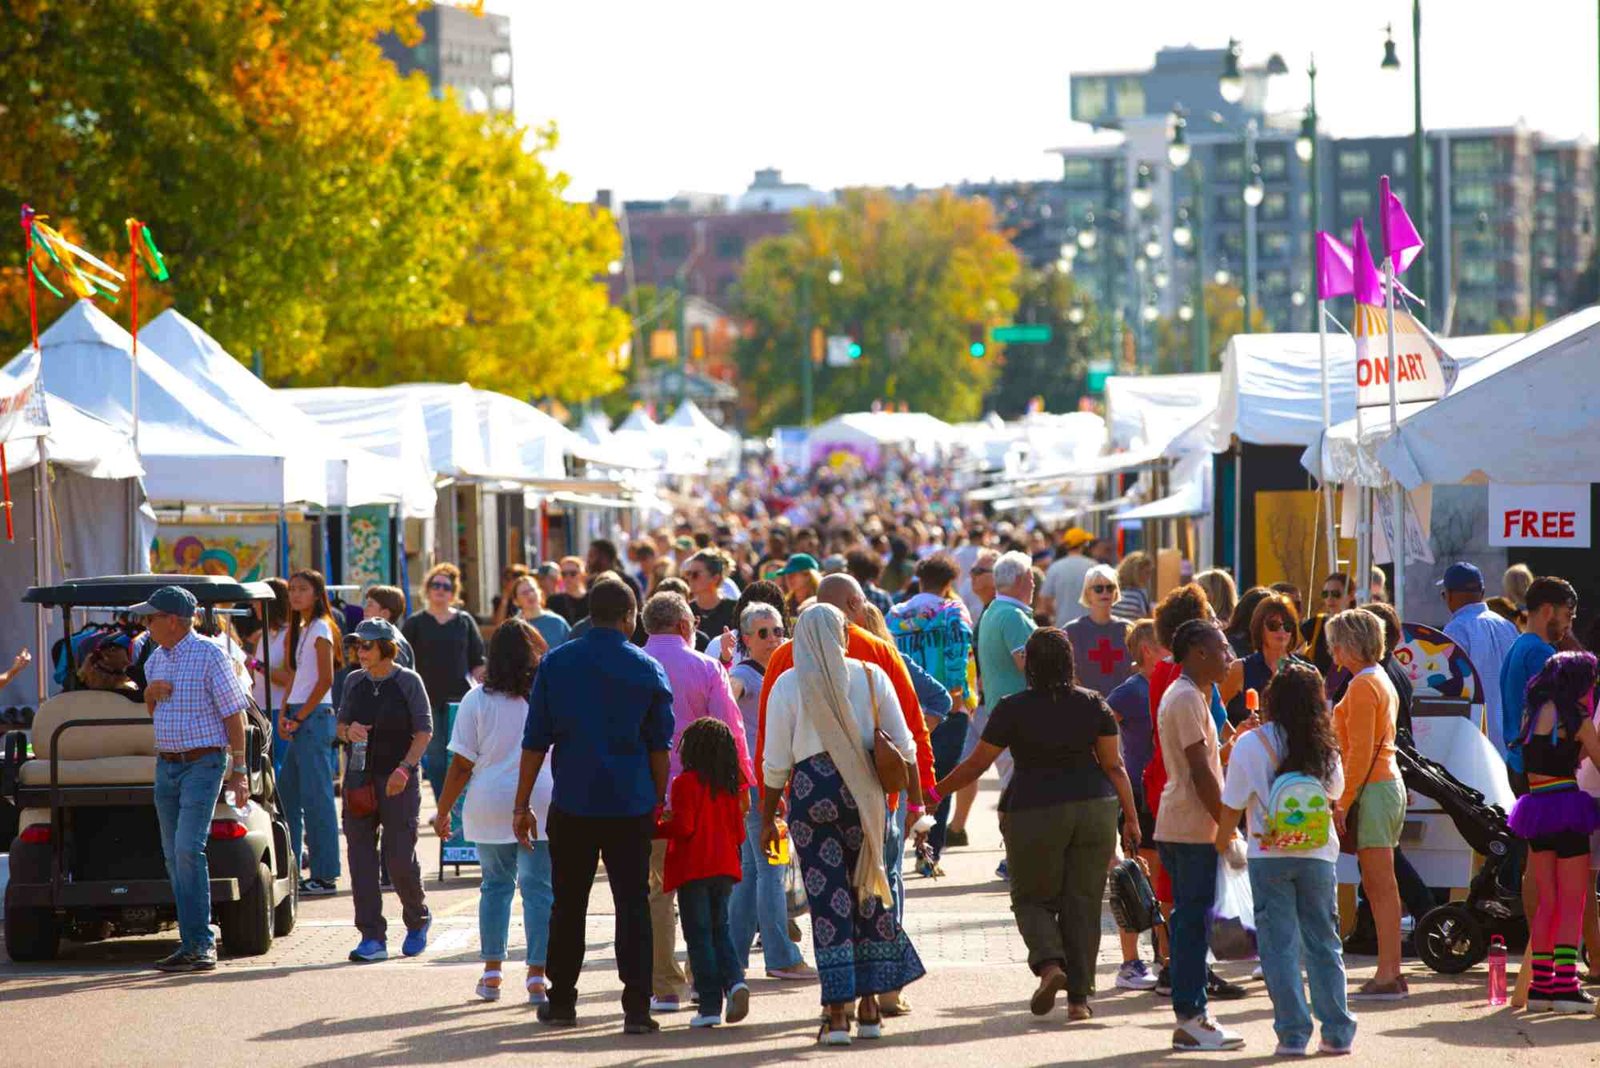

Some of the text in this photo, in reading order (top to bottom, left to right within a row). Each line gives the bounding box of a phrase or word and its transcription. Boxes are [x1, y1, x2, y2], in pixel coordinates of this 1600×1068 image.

[1356, 356, 1389, 386] ON
[1398, 353, 1427, 382] ART
[1504, 509, 1576, 538] FREE
